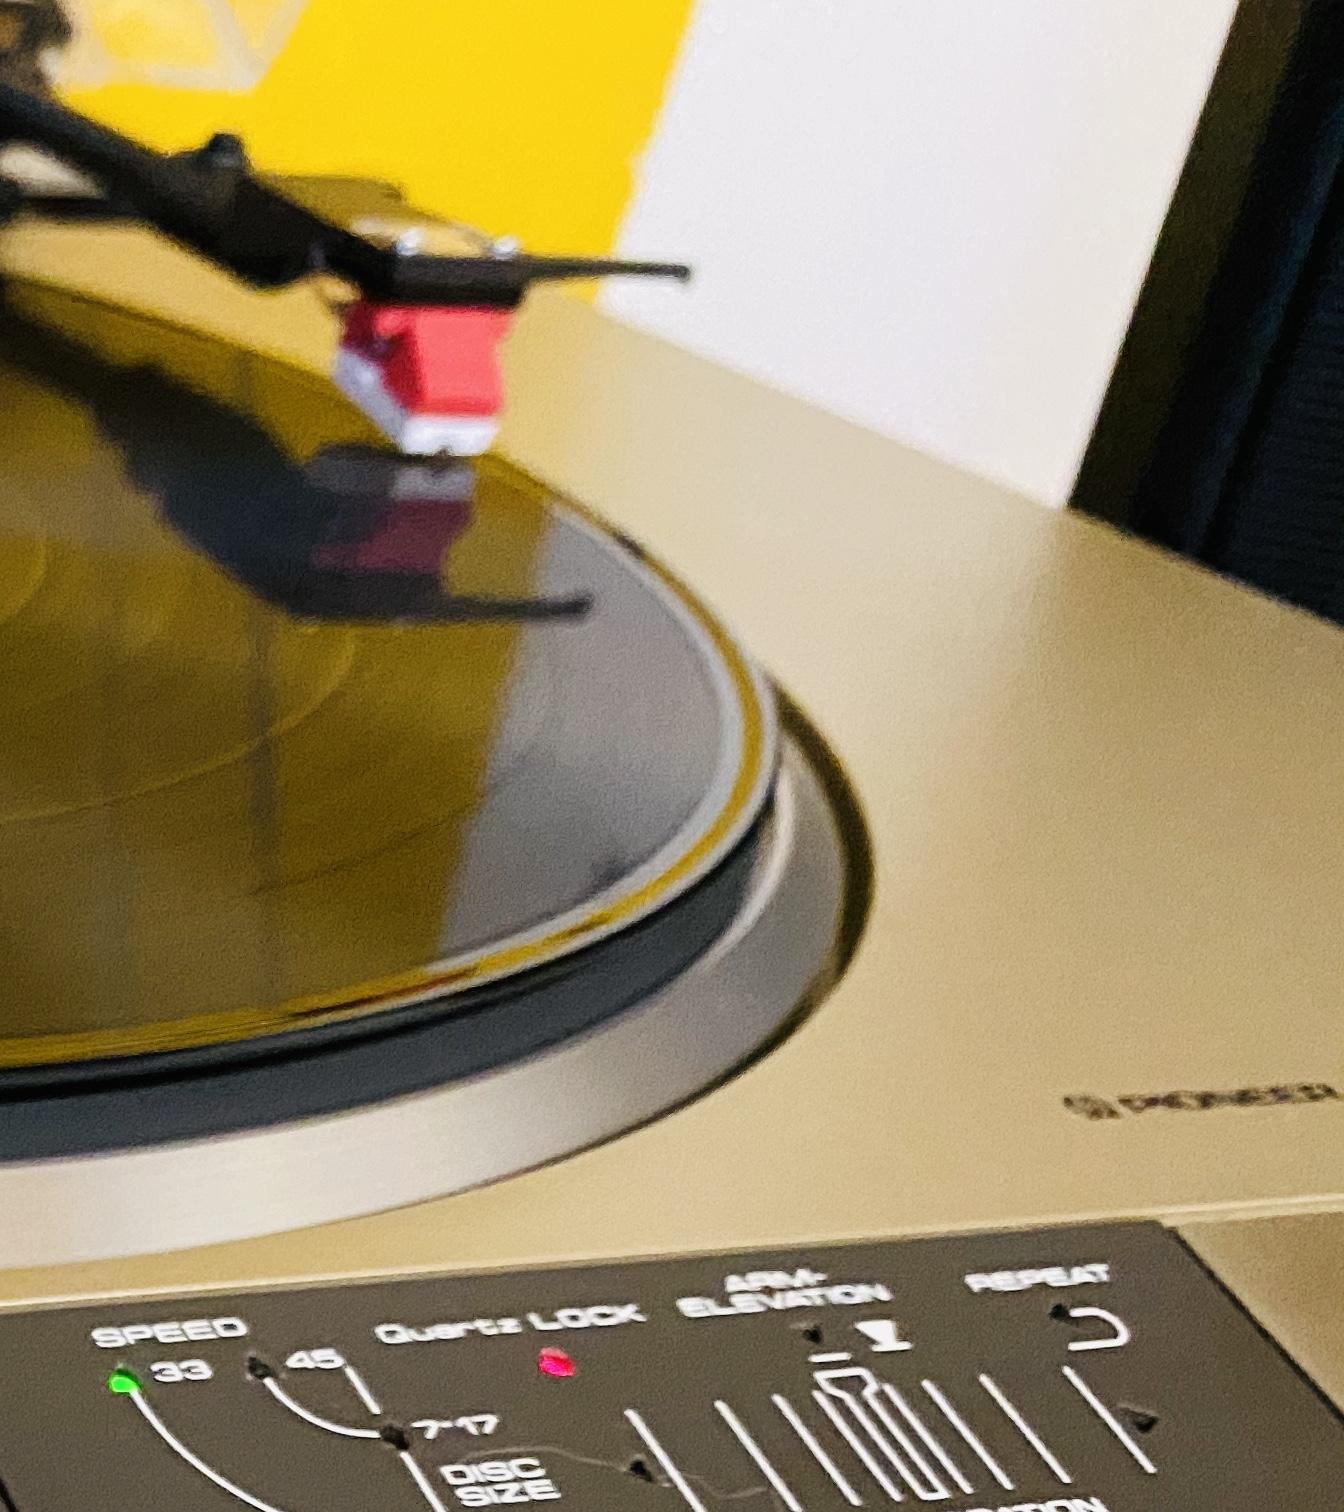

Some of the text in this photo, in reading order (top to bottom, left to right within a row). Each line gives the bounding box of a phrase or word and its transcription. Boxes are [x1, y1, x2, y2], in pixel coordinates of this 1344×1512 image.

[964, 1263, 1111, 1293] REPEAT
[91, 1316, 248, 1348] SPEED
[374, 1303, 648, 1344] Quartz LOCK
[149, 1359, 212, 1383] 33
[284, 1348, 345, 1371] 45
[439, 1457, 546, 1486] DISC
[454, 1478, 562, 1507] SIZE
